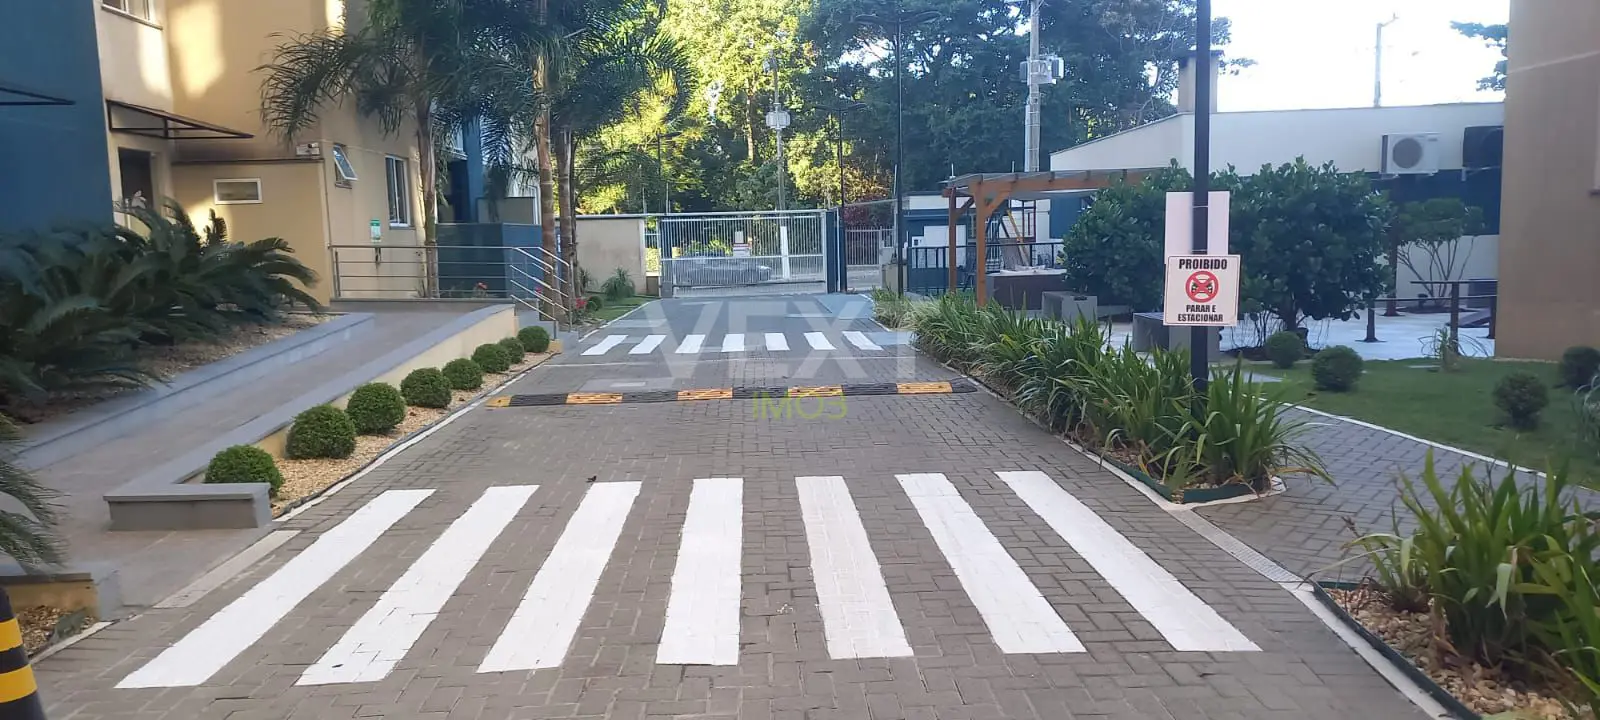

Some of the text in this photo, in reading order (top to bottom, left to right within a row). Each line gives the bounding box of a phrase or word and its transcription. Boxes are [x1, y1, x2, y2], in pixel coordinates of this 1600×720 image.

[1178, 258, 1228, 270] PROIBIDO
[1186, 304, 1216, 312] PARAR E
[1178, 314, 1224, 322] ESTACIONAR
